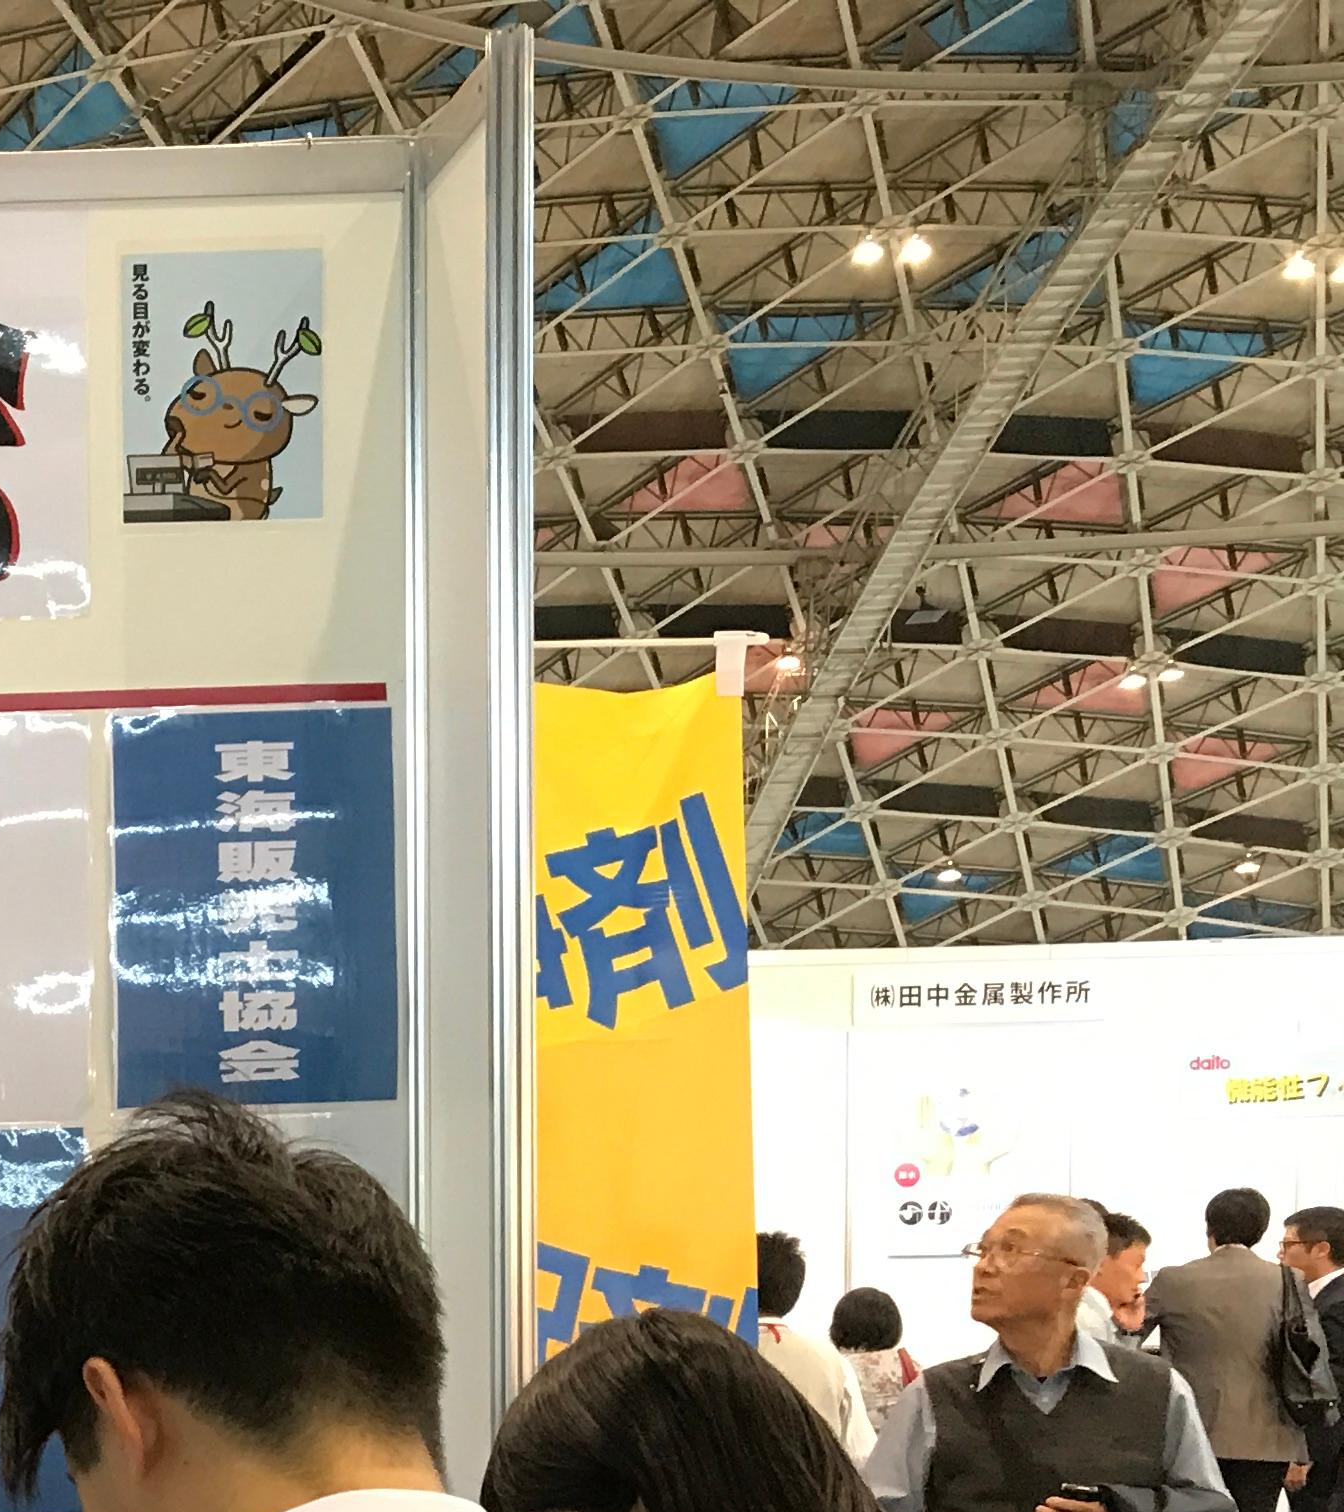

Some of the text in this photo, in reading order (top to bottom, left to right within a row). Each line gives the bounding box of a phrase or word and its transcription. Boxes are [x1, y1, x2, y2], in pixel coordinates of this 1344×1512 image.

[131, 263, 152, 402] 見る目が変わる。
